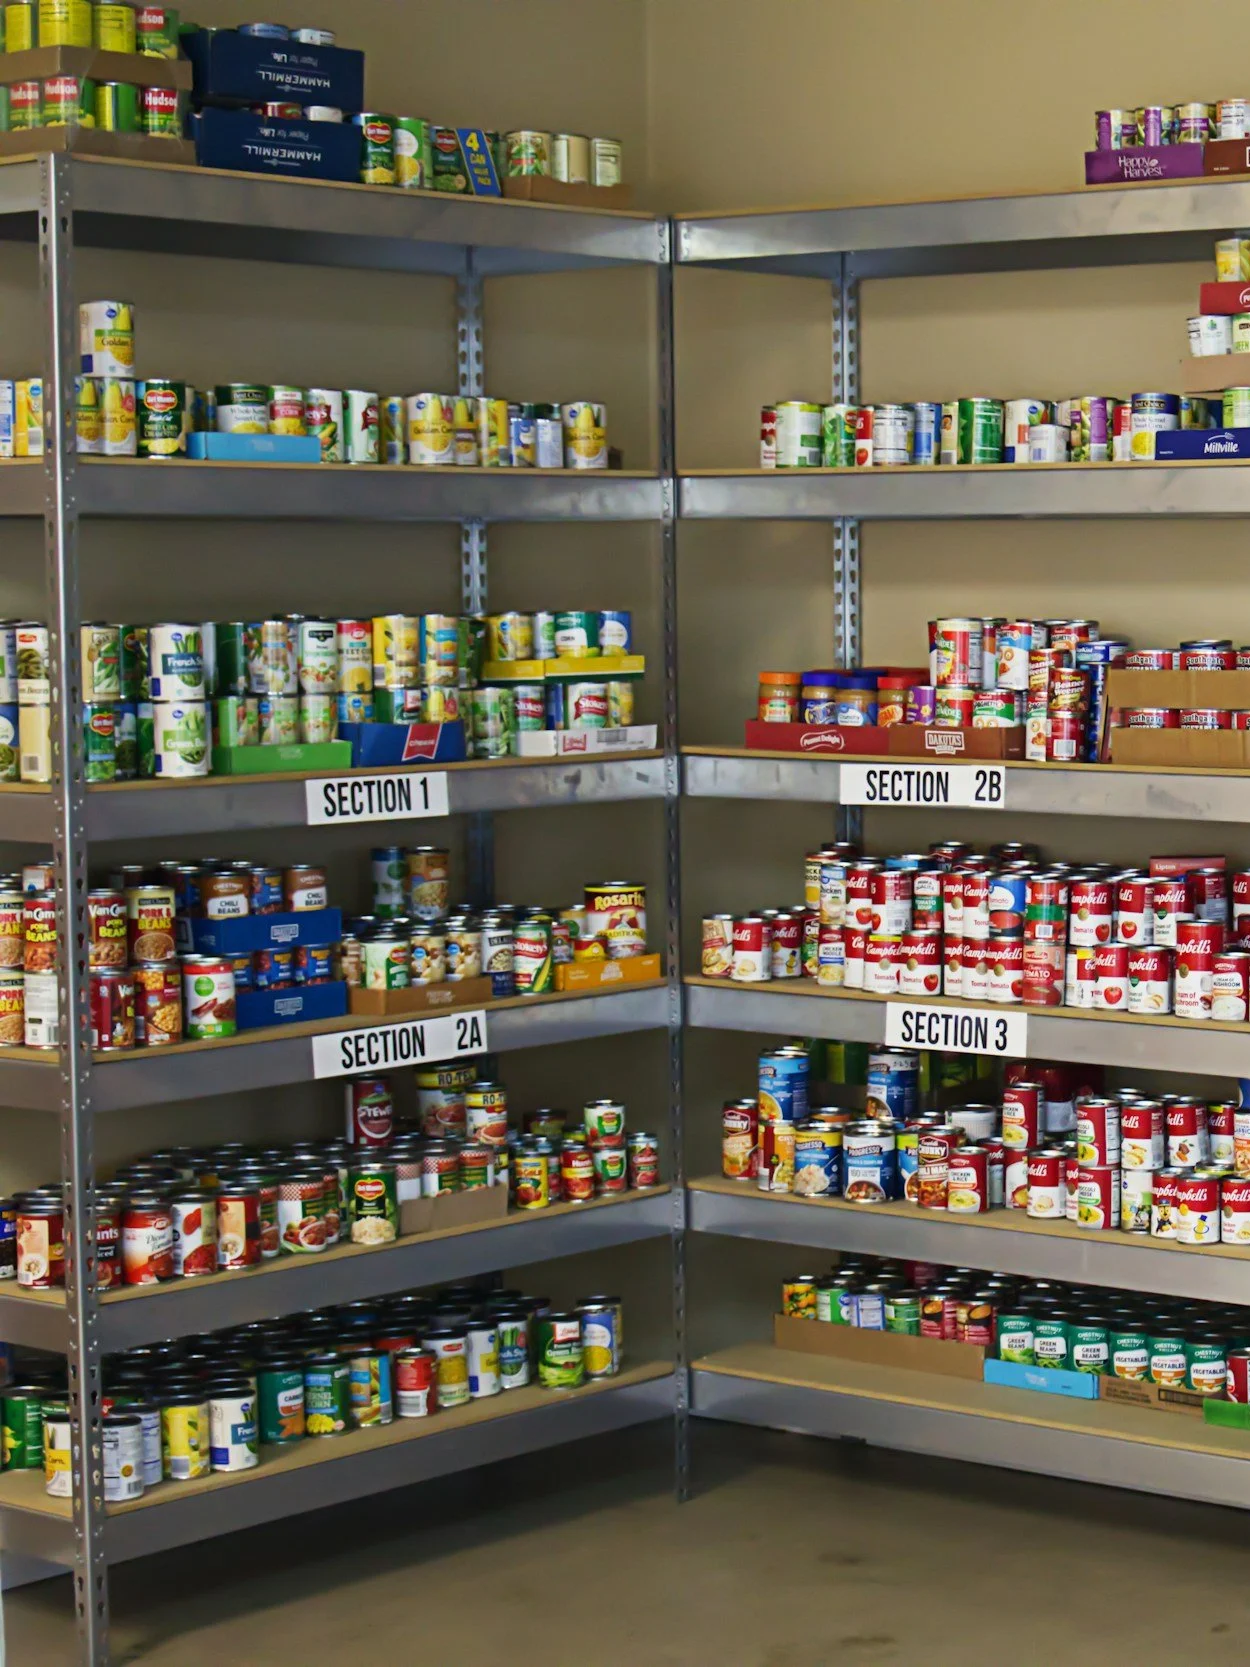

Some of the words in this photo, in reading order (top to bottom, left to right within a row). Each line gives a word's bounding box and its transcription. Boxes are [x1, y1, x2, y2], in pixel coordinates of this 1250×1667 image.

[257, 71, 330, 88] HAMMERMILL
[45, 80, 77, 94] Hudson
[466, 132, 479, 150] 4
[242, 145, 321, 161] HAMMERMILL
[470, 154, 486, 165] CAN
[1119, 155, 1151, 172] Happy
[1124, 166, 1164, 178] Harvest
[101, 337, 130, 346] Golden
[1142, 400, 1165, 408] Choice
[1204, 442, 1238, 454] Millville
[1187, 657, 1224, 666] Southgate
[1130, 715, 1162, 725] Southgate
[1182, 714, 1216, 724] Southgate
[928, 734, 962, 746] DAKOTA'S
[866, 770, 948, 802] SECTION
[976, 770, 1001, 802] 2B
[324, 778, 410, 817] SECTION
[420, 777, 429, 810] 1
[218, 907, 240, 915] BEANS
[138, 919, 171, 930] BEANS
[902, 1011, 988, 1049] SECTION
[995, 1019, 1008, 1050] 3
[341, 1026, 425, 1069] SECTION
[457, 1017, 482, 1050] 2A
